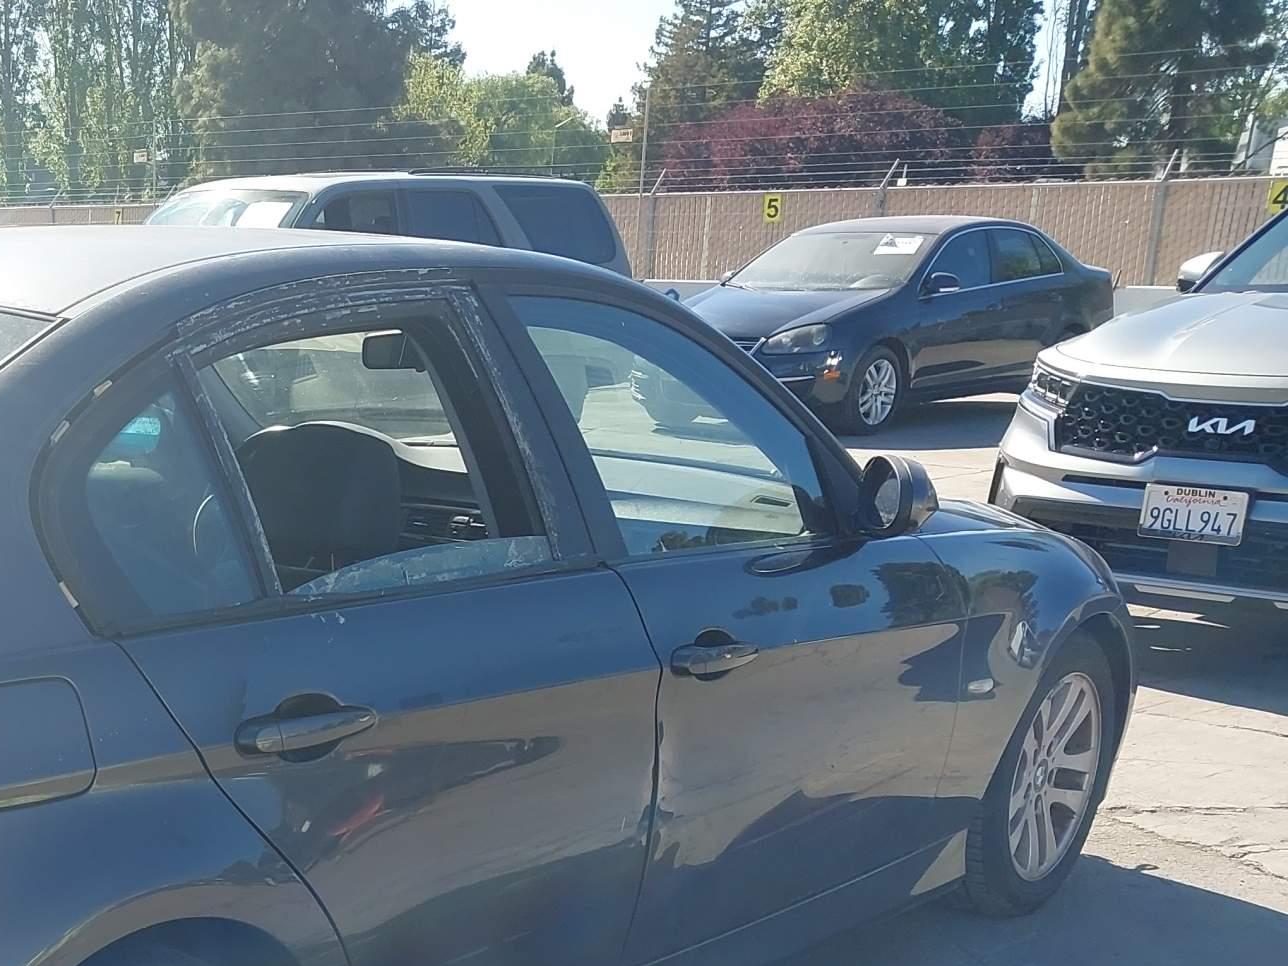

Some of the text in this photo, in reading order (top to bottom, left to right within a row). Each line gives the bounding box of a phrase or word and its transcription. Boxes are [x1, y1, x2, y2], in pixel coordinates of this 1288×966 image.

[1272, 185, 1288, 209] 4
[115, 210, 121, 224] 7
[766, 198, 779, 218] 5
[1188, 416, 1256, 436] KIA
[1165, 494, 1227, 508] California
[1176, 488, 1216, 499] DUBLIN
[1149, 506, 1238, 537] 9GLL947
